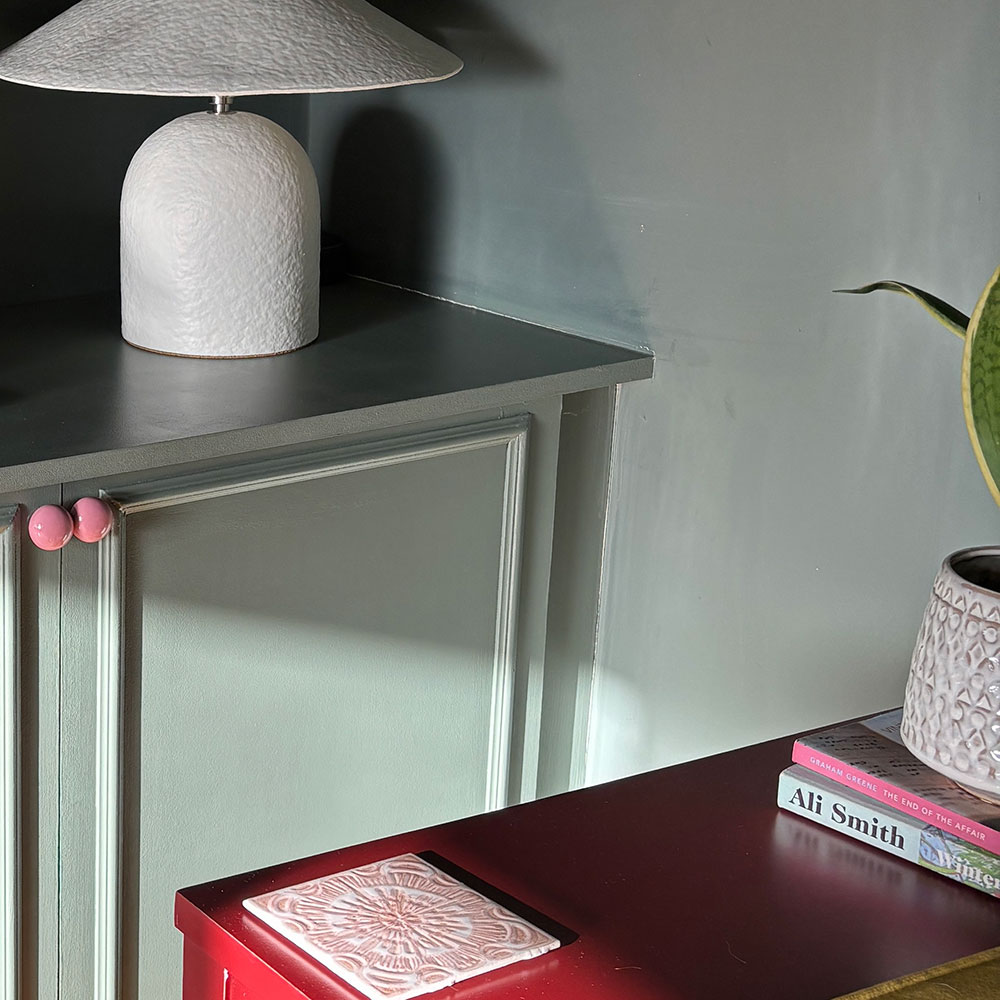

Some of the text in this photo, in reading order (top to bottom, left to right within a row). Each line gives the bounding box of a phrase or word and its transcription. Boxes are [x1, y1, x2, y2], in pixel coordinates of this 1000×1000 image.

[788, 787, 905, 851] Ali Smith
[809, 756, 843, 777] GRAHAM
[846, 774, 878, 793] GREENE
[882, 789, 899, 802] THE
[901, 797, 919, 811] END
[921, 806, 934, 817] OF
[935, 812, 952, 827] THE
[954, 822, 986, 842] AFFAIR
